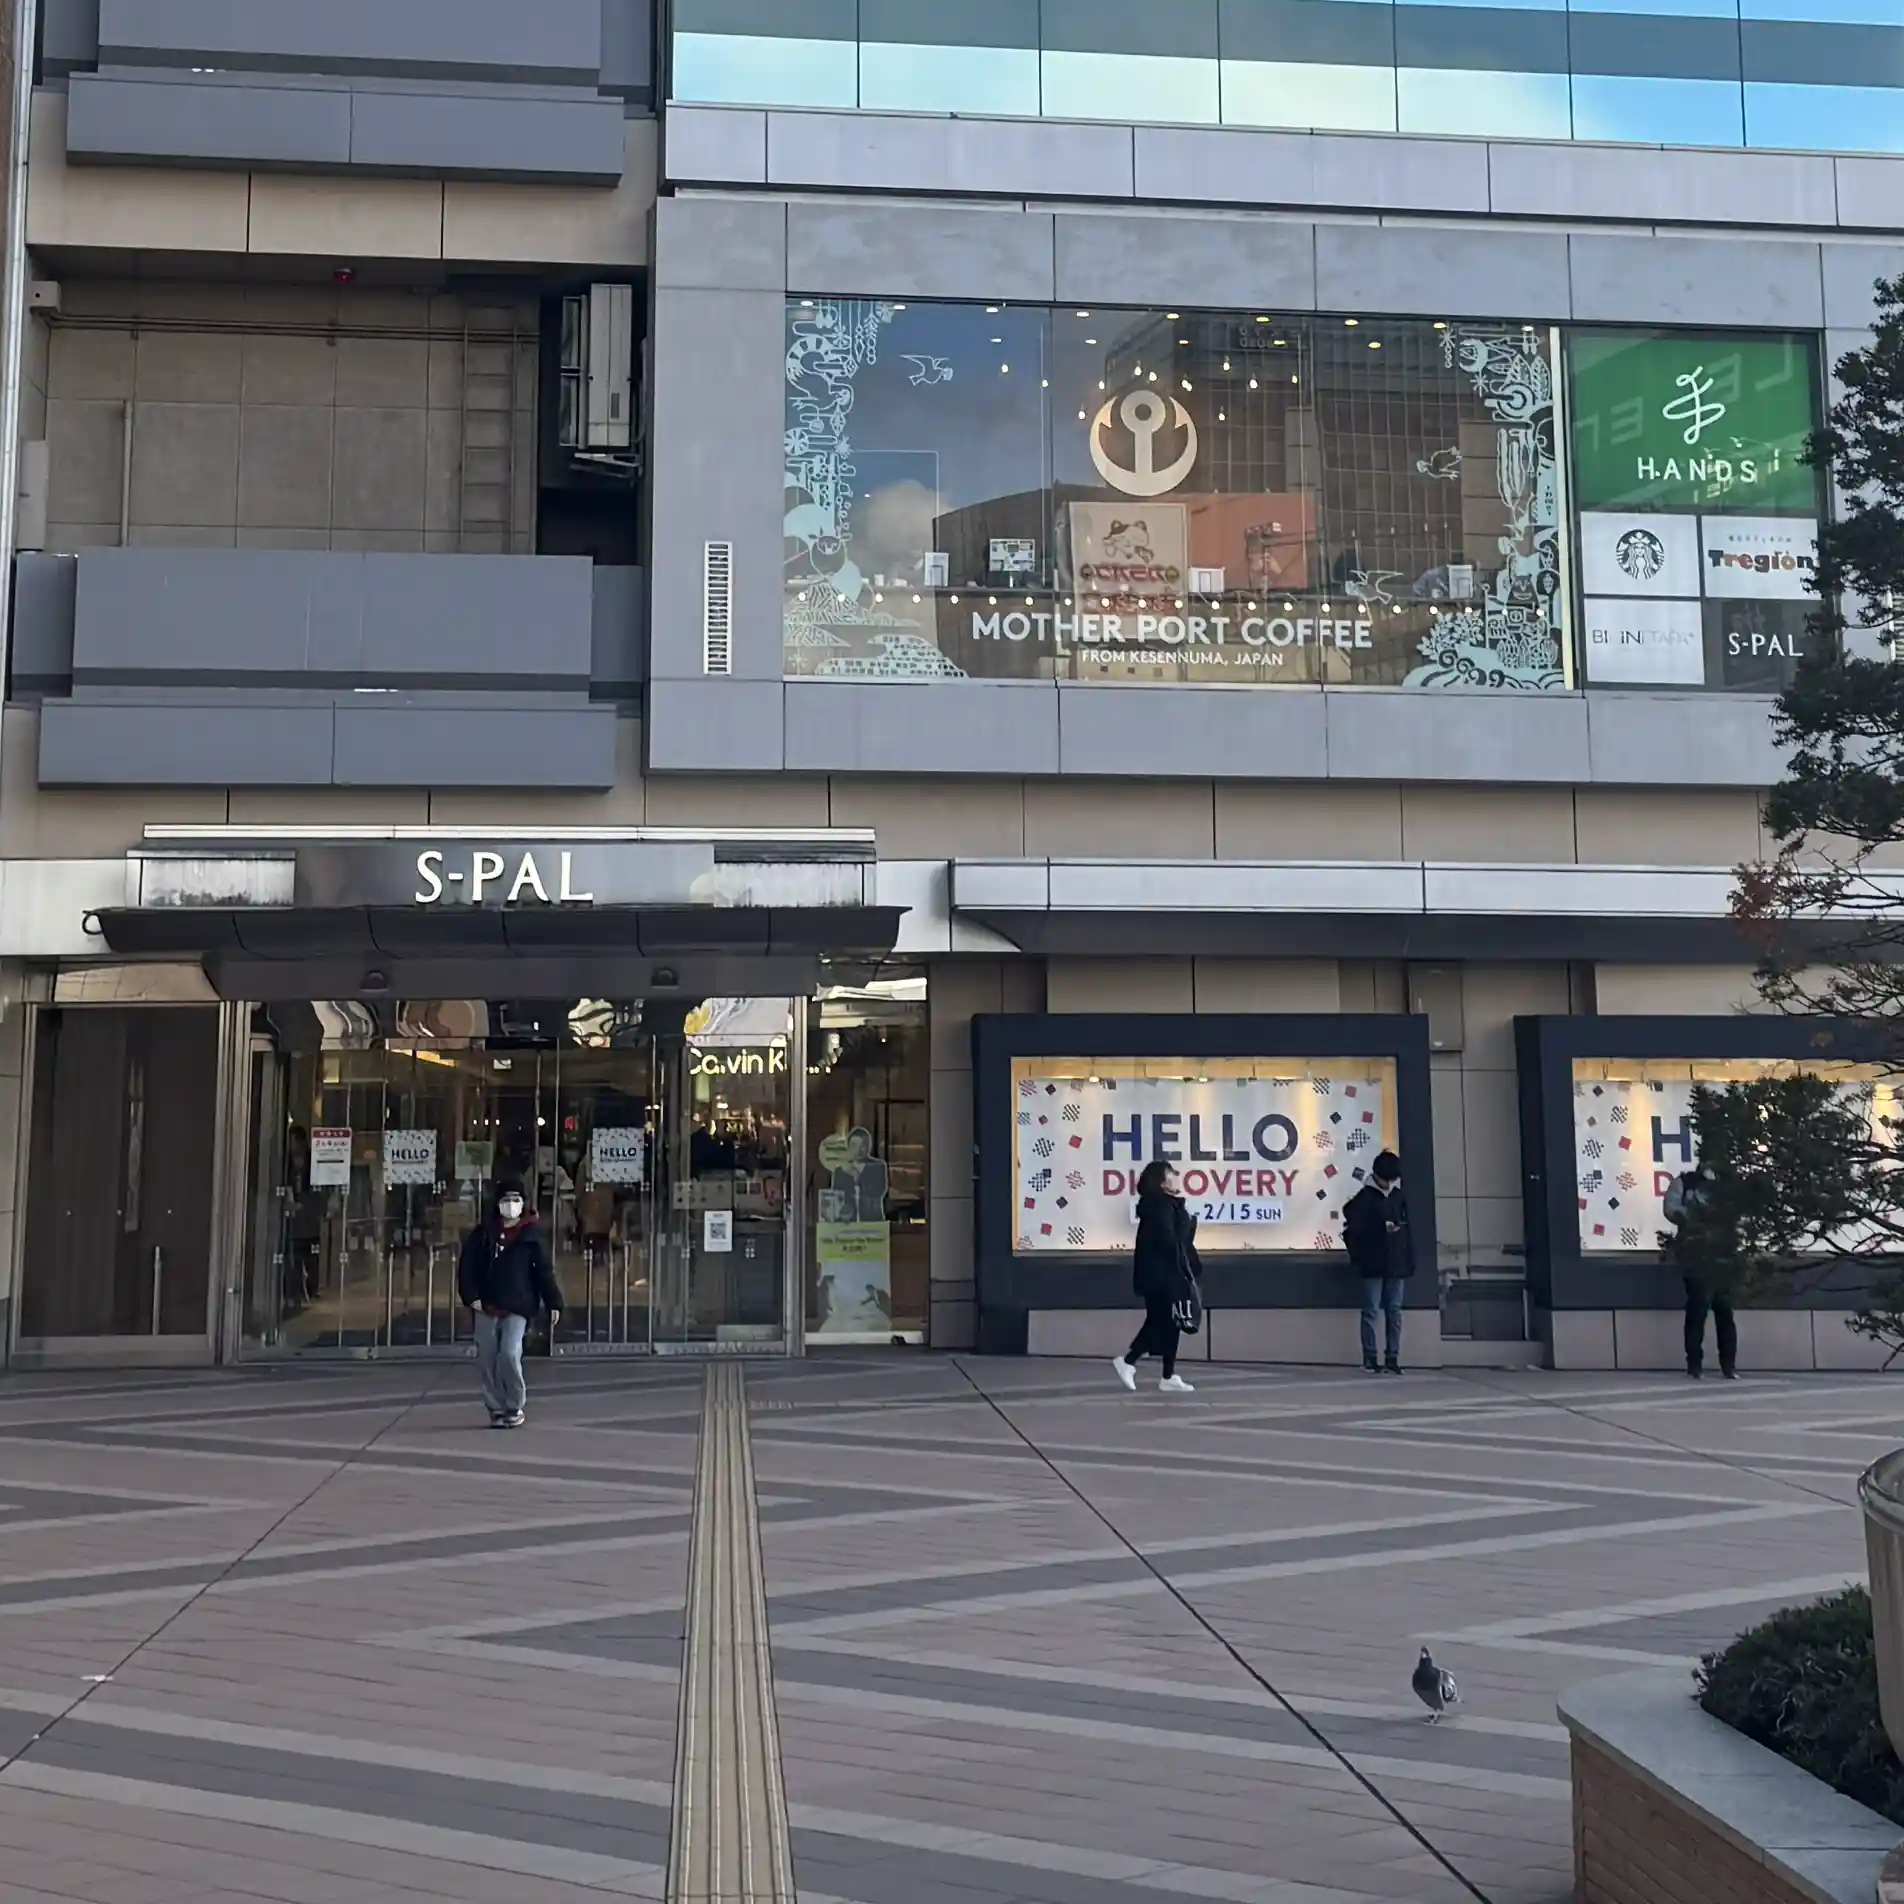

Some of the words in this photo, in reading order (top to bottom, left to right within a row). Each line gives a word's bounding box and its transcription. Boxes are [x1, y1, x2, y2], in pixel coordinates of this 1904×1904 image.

[1636, 456, 1757, 484] HANDS
[971, 610, 1123, 644] MOTHER
[1137, 615, 1230, 646] PORT
[1240, 617, 1374, 649] COFFEE
[1728, 632, 1804, 657] S-PAL
[1081, 649, 1126, 664] FROM
[1130, 651, 1229, 666] KESENNUMA,
[1233, 652, 1285, 667] JAPAN
[414, 850, 595, 905] S-PAL
[1102, 1113, 1299, 1162] HELLO
[391, 1148, 430, 1160] HELLO
[599, 1147, 638, 1158] HELLO
[1102, 1169, 1299, 1197] DIOVERY
[1255, 1208, 1282, 1220] SUN
